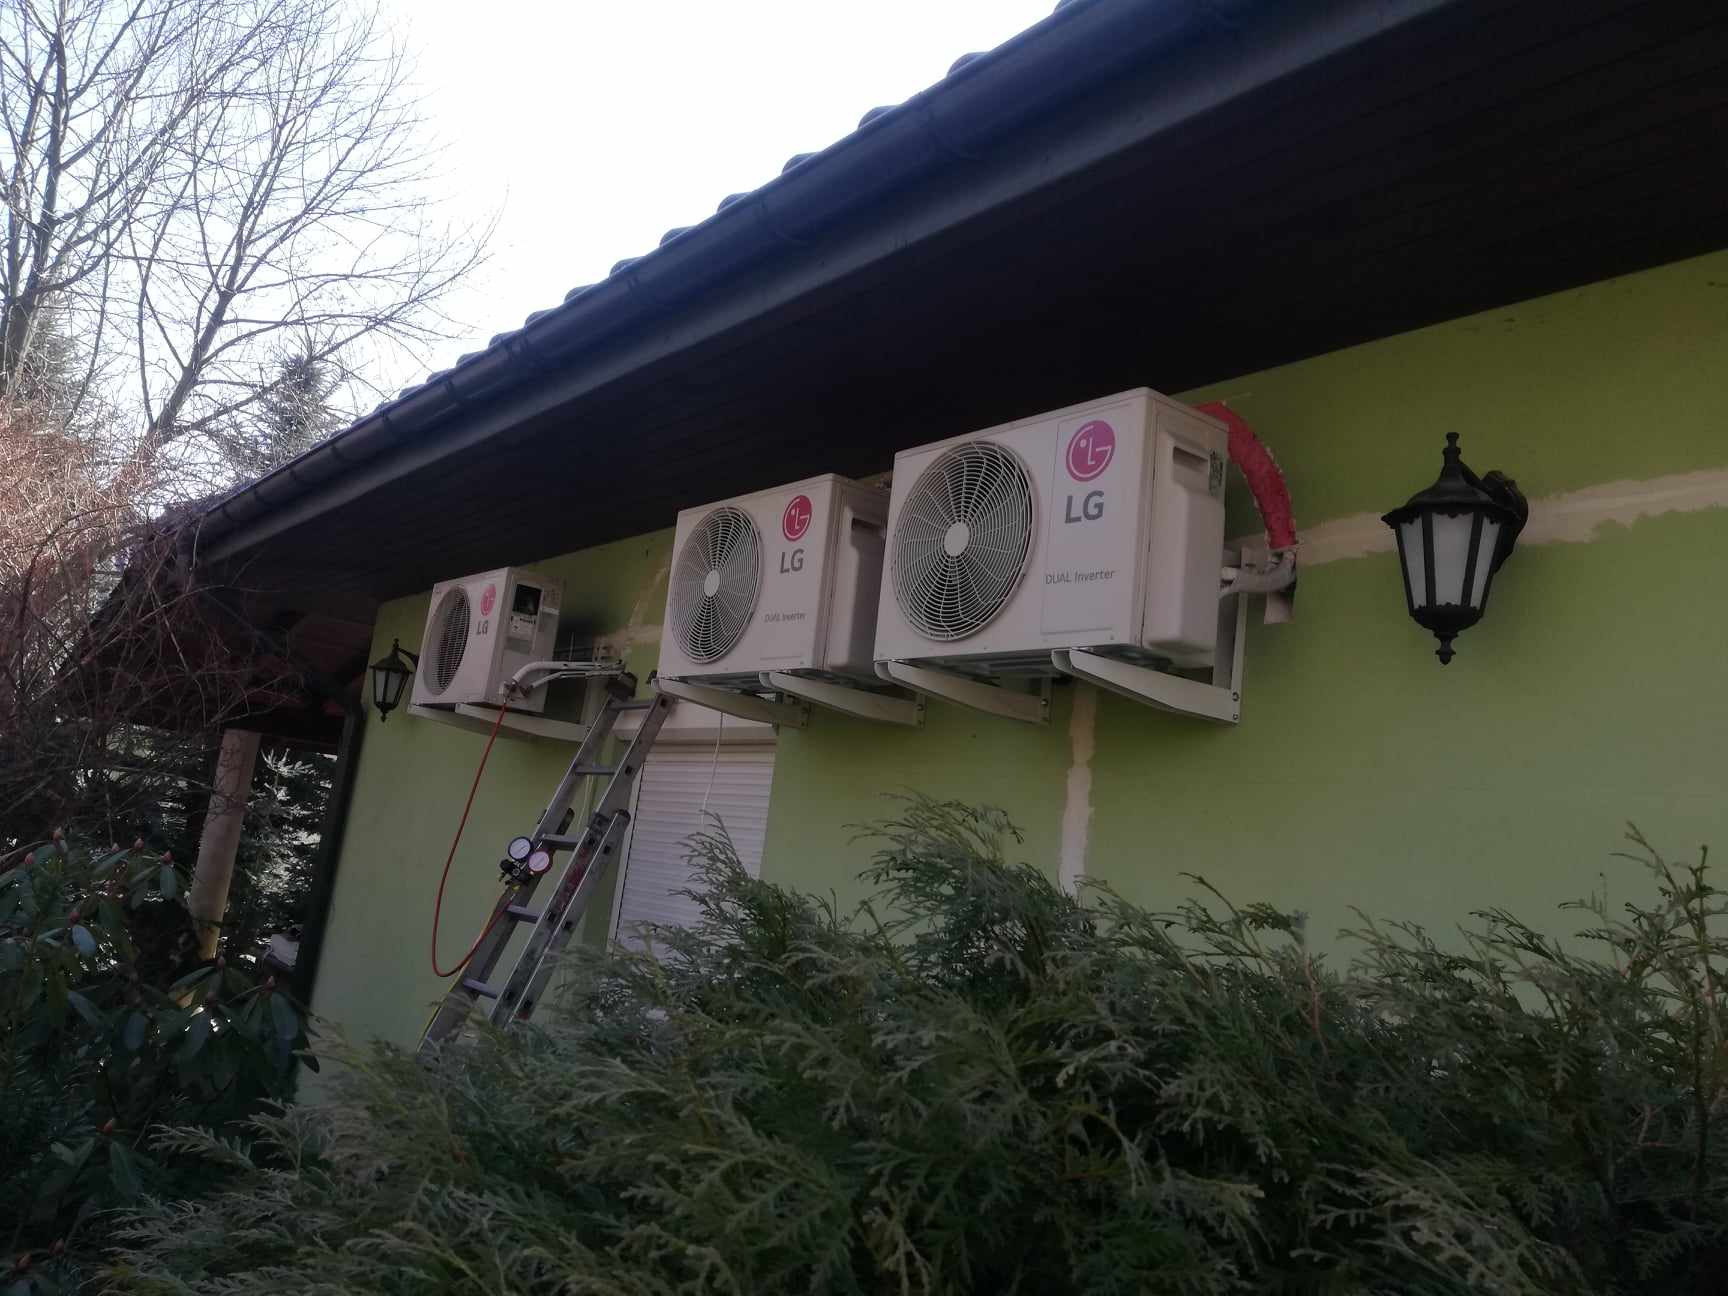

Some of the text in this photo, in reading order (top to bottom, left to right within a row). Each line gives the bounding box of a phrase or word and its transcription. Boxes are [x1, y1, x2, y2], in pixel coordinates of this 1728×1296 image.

[1064, 490, 1105, 524] LG
[780, 548, 805, 574] LG
[1045, 569, 1116, 585] DUAL Inverter
[476, 620, 489, 635] LG
